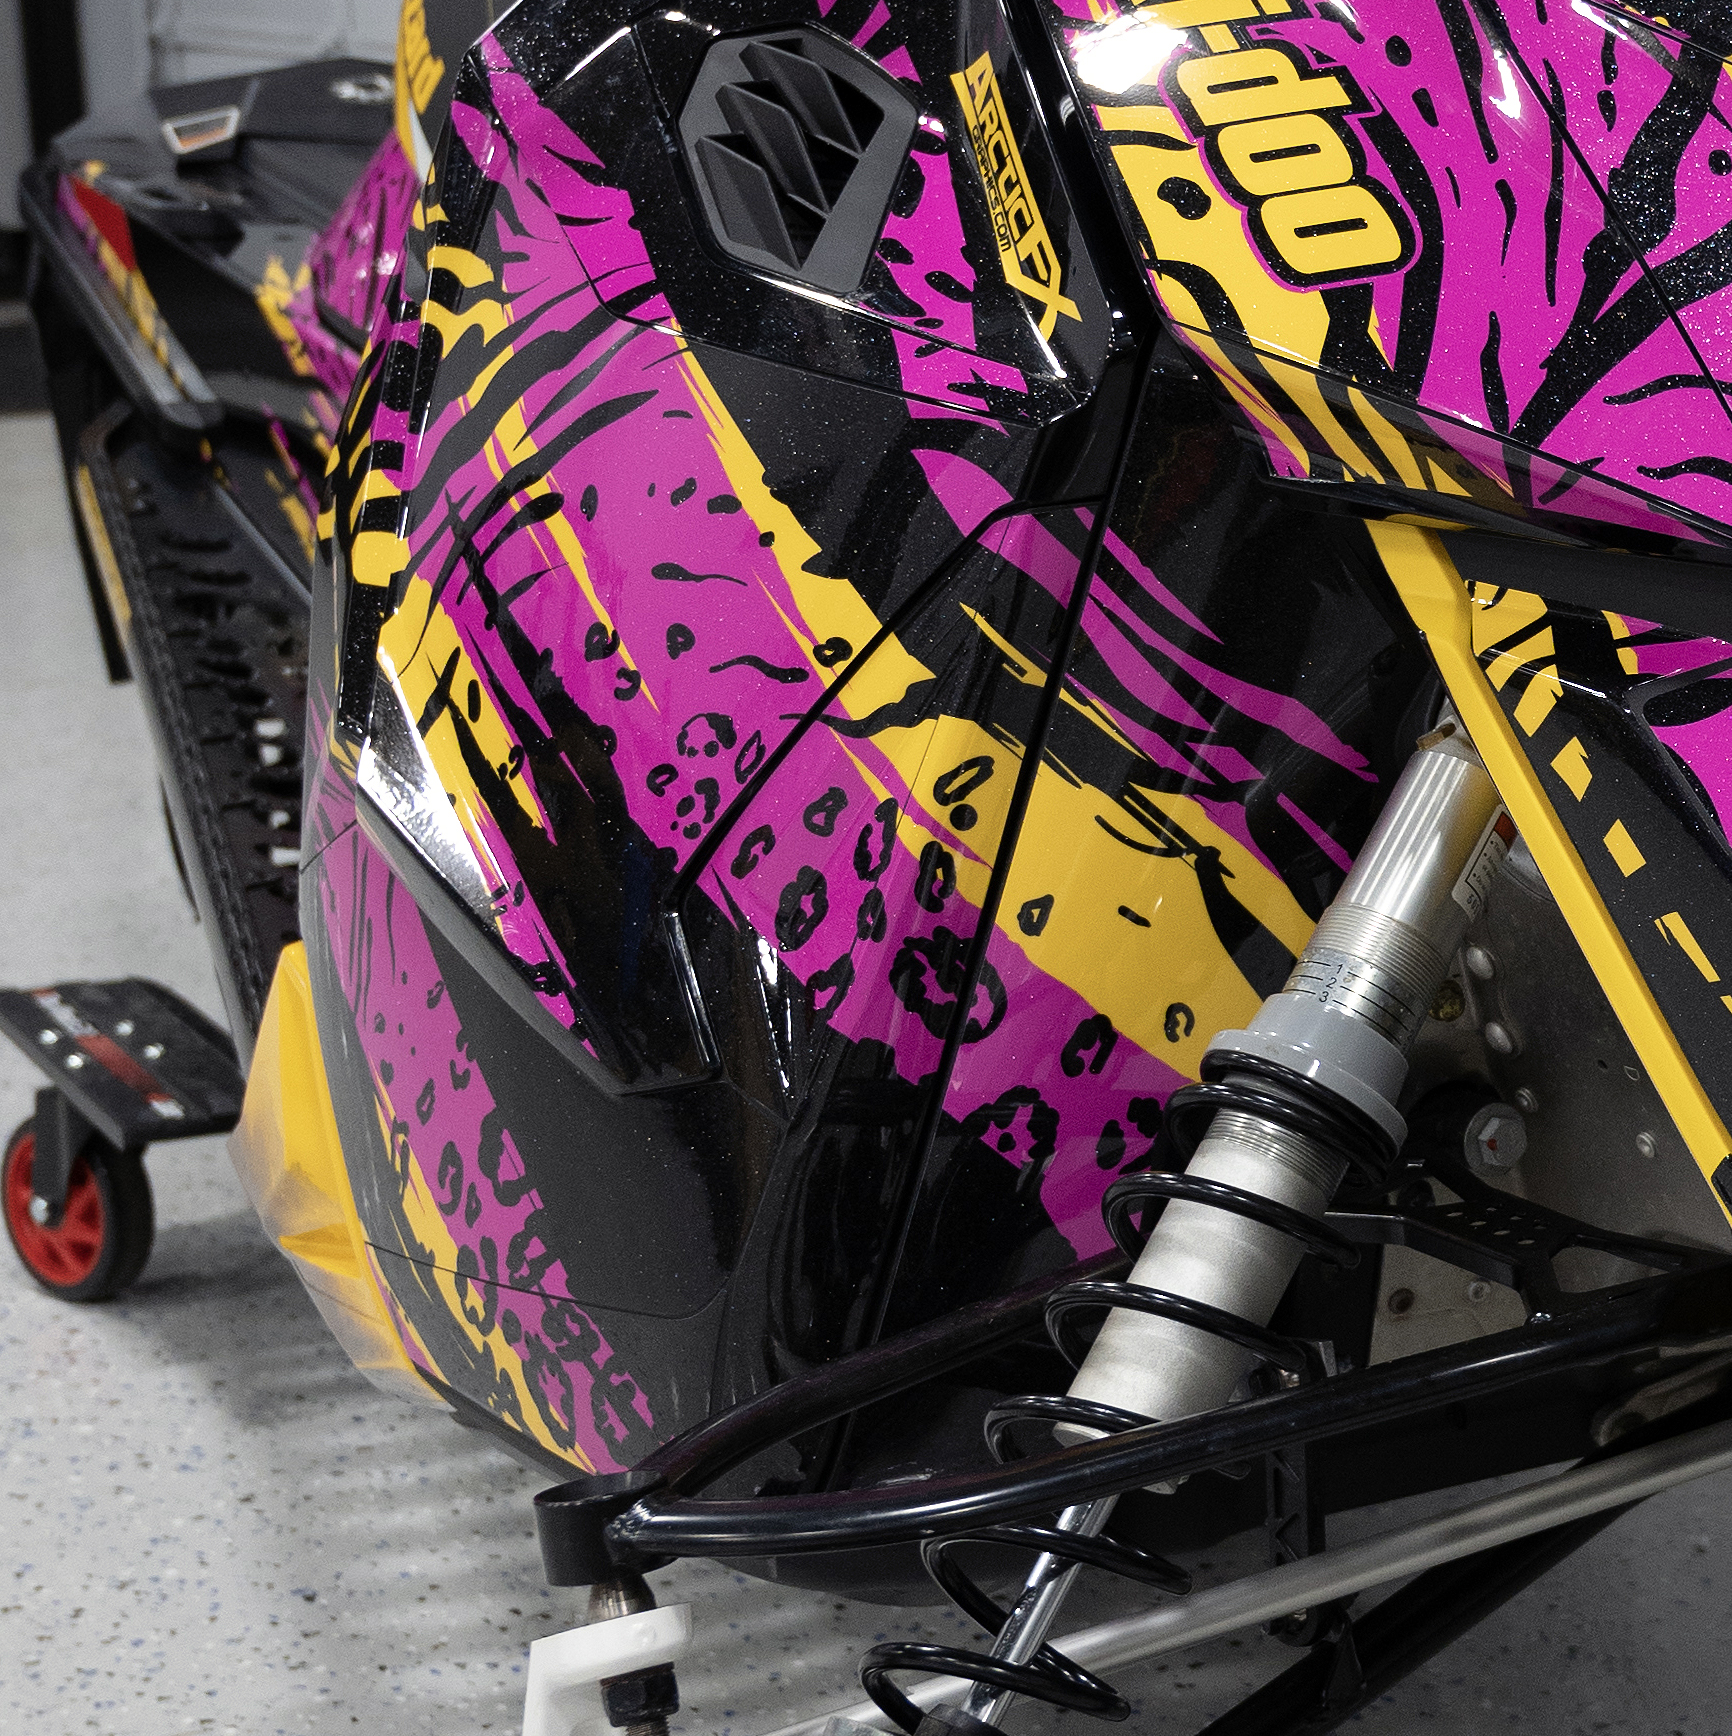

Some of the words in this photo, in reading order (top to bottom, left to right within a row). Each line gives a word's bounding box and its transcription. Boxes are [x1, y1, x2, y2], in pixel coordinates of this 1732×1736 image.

[1336, 964, 1343, 974] 1
[1326, 977, 1337, 989] 2
[1318, 990, 1329, 1003] 3
